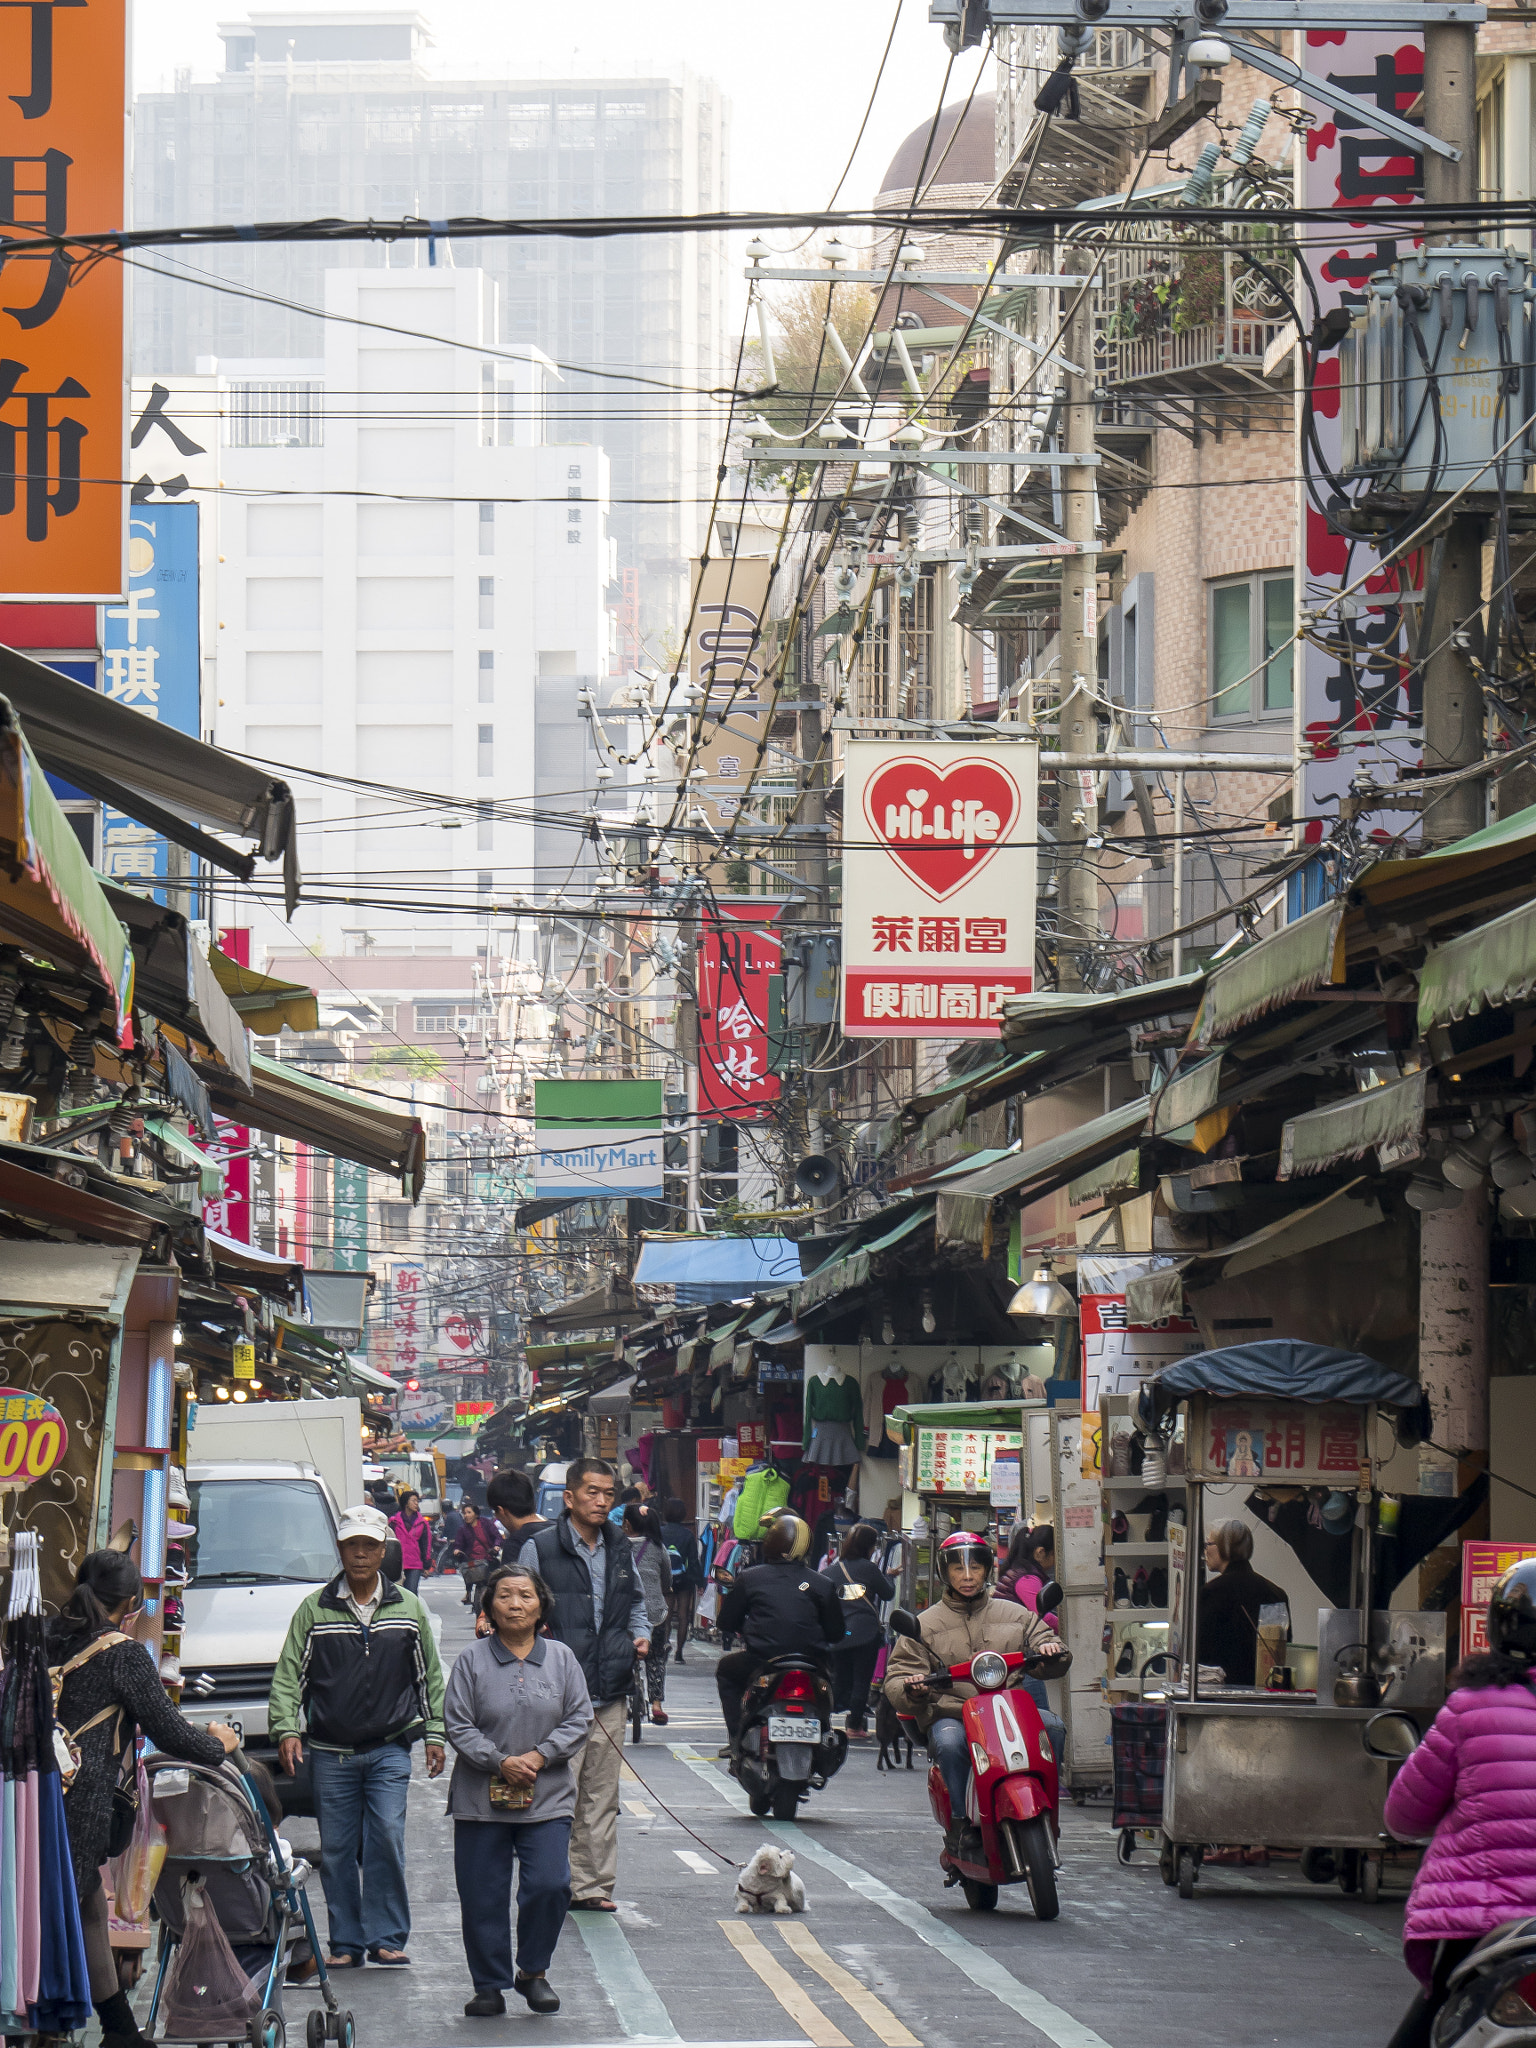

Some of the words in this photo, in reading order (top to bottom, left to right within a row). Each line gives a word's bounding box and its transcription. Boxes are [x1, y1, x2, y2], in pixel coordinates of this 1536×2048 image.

[872, 916, 1007, 953] 萊爾富
[862, 983, 1016, 1020] 便利商店
[715, 996, 765, 1091] 哈林
[541, 1149, 657, 1172] FamilyMart
[394, 1270, 421, 1370] 新口味海
[965, 1434, 977, 1478] 木瓜牛奶
